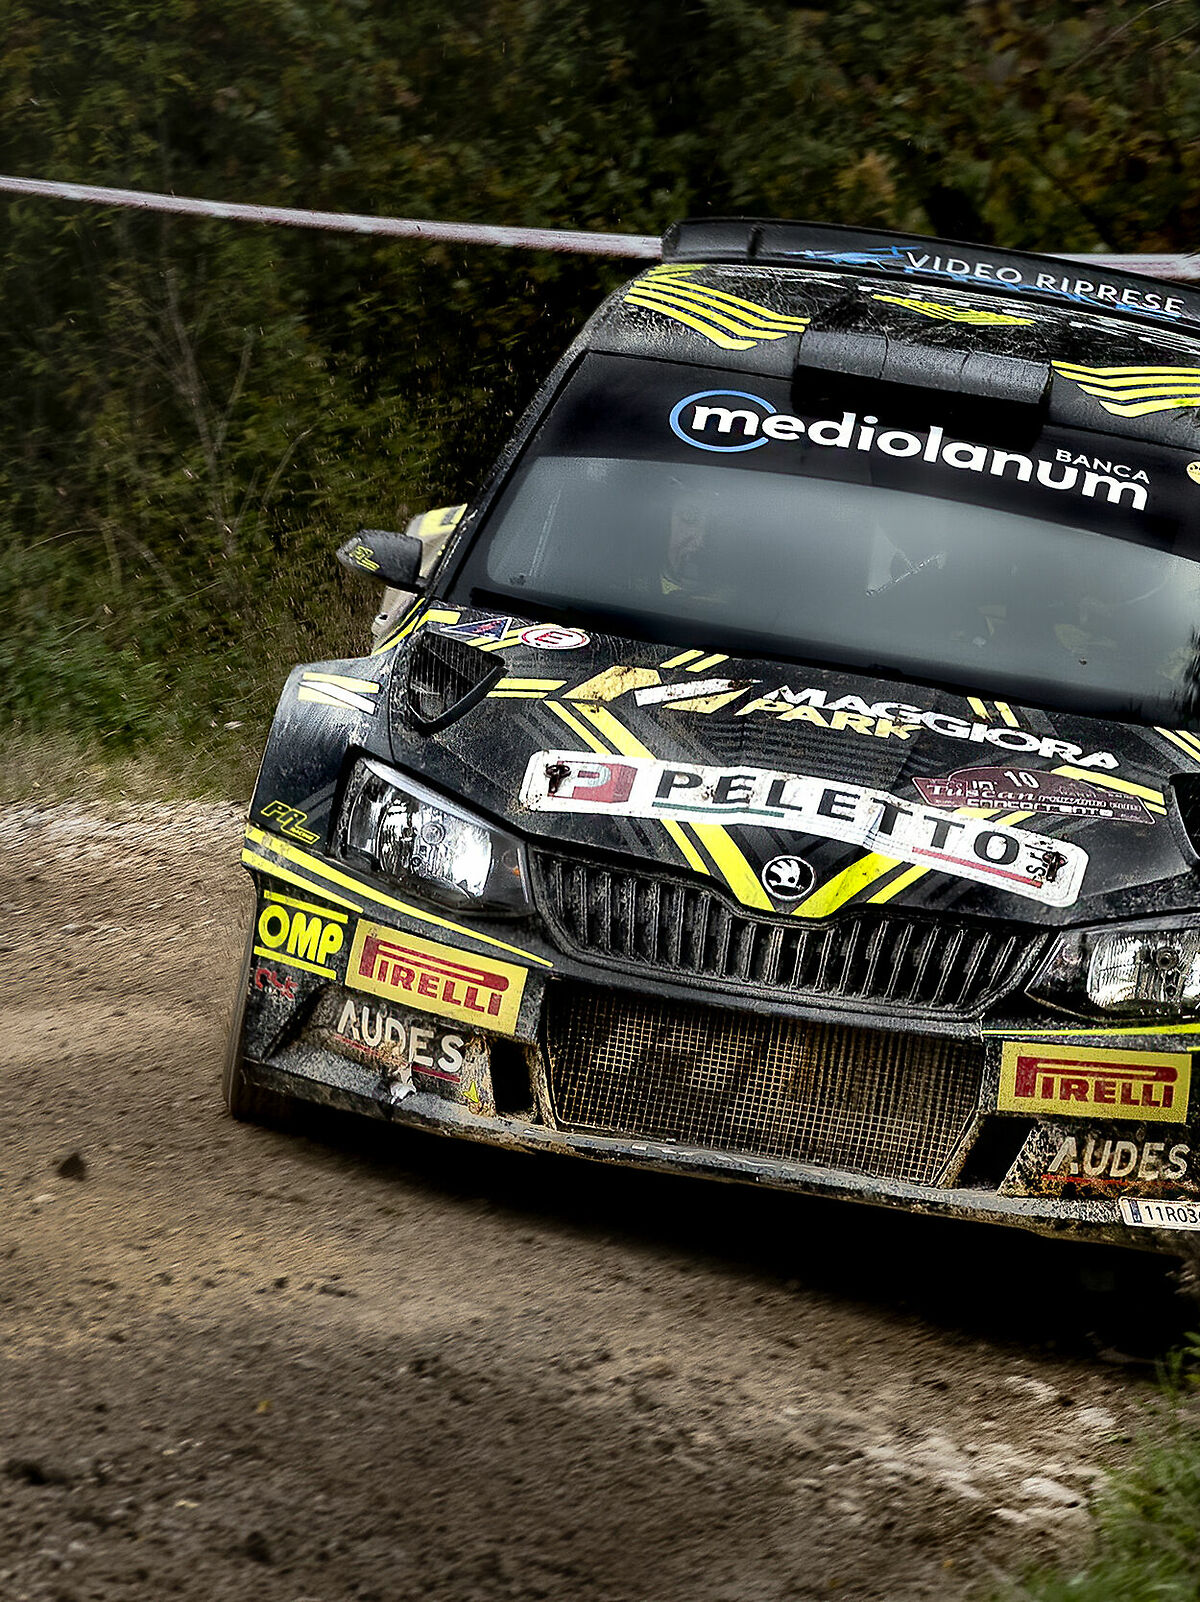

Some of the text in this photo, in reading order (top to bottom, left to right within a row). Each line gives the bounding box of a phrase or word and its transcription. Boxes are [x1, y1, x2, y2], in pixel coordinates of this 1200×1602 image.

[906, 250, 1185, 316] VIDEO RIPRESE
[691, 405, 1149, 512] mediolanum
[1055, 448, 1151, 485] BANCA
[734, 698, 926, 740] PARK
[762, 684, 1120, 770] MAGGIORA
[1003, 770, 1041, 790] 10
[655, 768, 1020, 866] PELETTO
[257, 904, 345, 967] OMP
[358, 934, 510, 1017] PIRELLI
[336, 999, 465, 1074] AUDES
[1014, 1055, 1179, 1109] PIRELLI
[1048, 1136, 1191, 1180] AUDES
